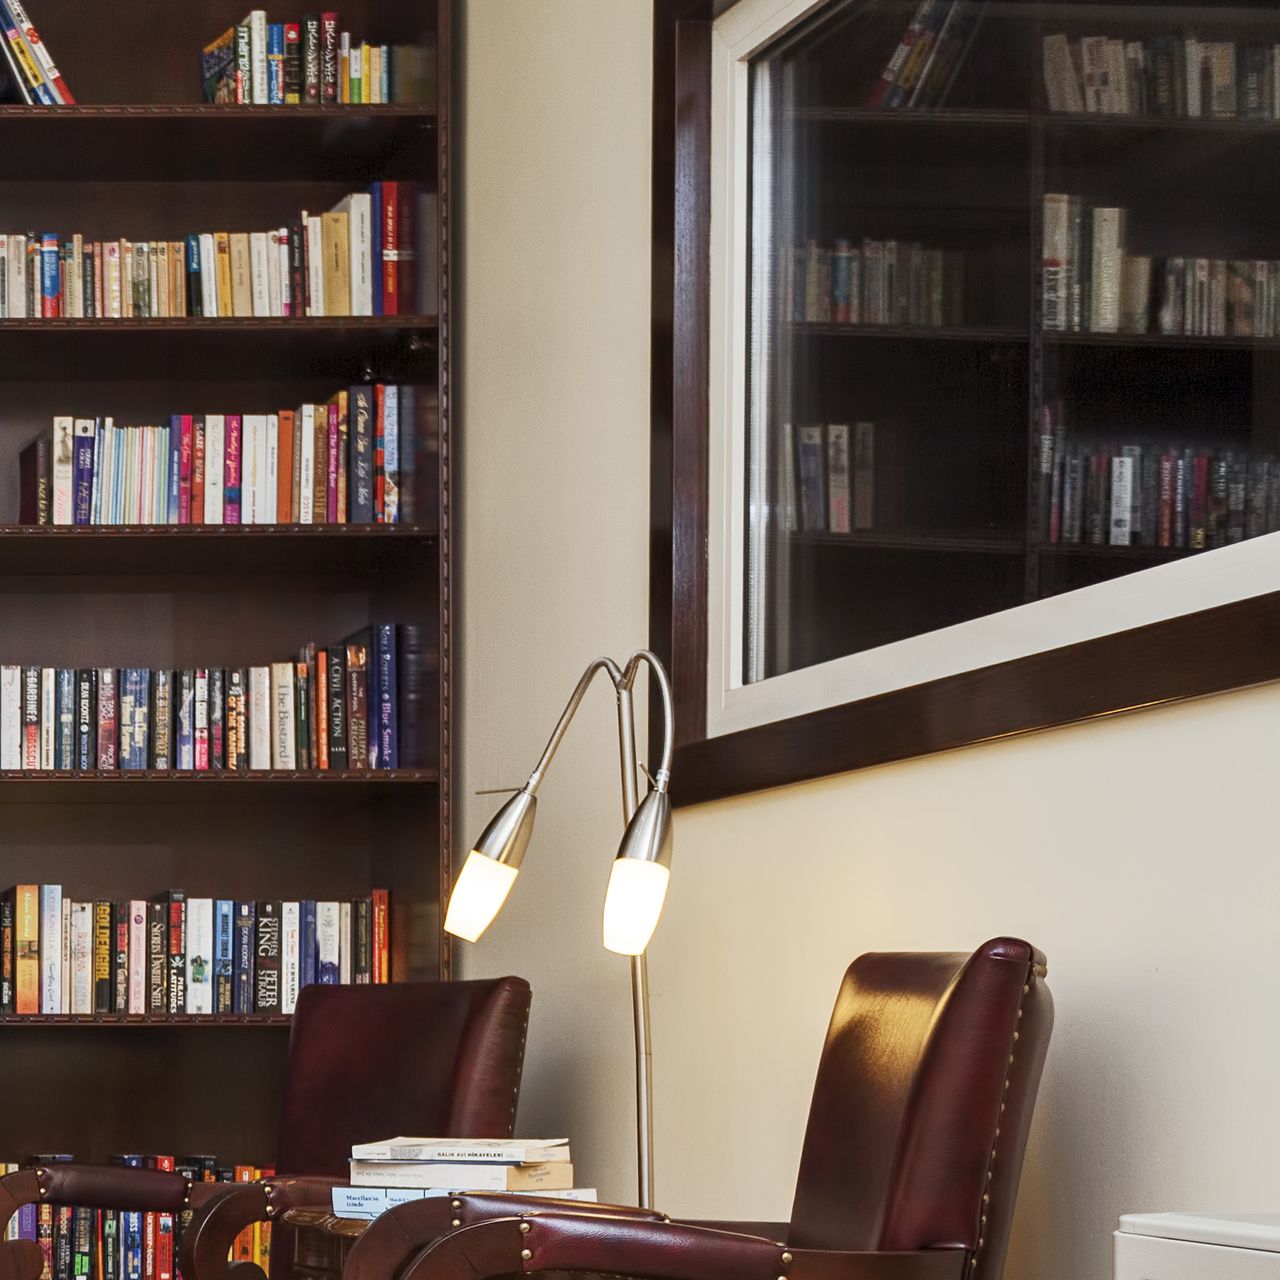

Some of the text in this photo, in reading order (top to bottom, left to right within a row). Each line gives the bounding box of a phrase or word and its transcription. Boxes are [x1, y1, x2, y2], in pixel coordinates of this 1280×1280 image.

[329, 433, 337, 448] The
[81, 682, 89, 723] DEAN KOONTZ
[228, 696, 236, 726] OF THE
[237, 696, 245, 714] THE
[332, 666, 342, 738] CIVIL ACTION
[280, 684, 290, 760] The Bastard
[382, 702, 391, 762] Blue Smoke
[96, 904, 110, 982] GOLDENGIRL
[240, 926, 248, 944] DEAN
[259, 917, 271, 956] KING
[270, 917, 278, 956] STEPHEN
[151, 986, 163, 1009] STEEL
[258, 969, 266, 1008] STRAUB
[266, 969, 277, 1007] PETER
